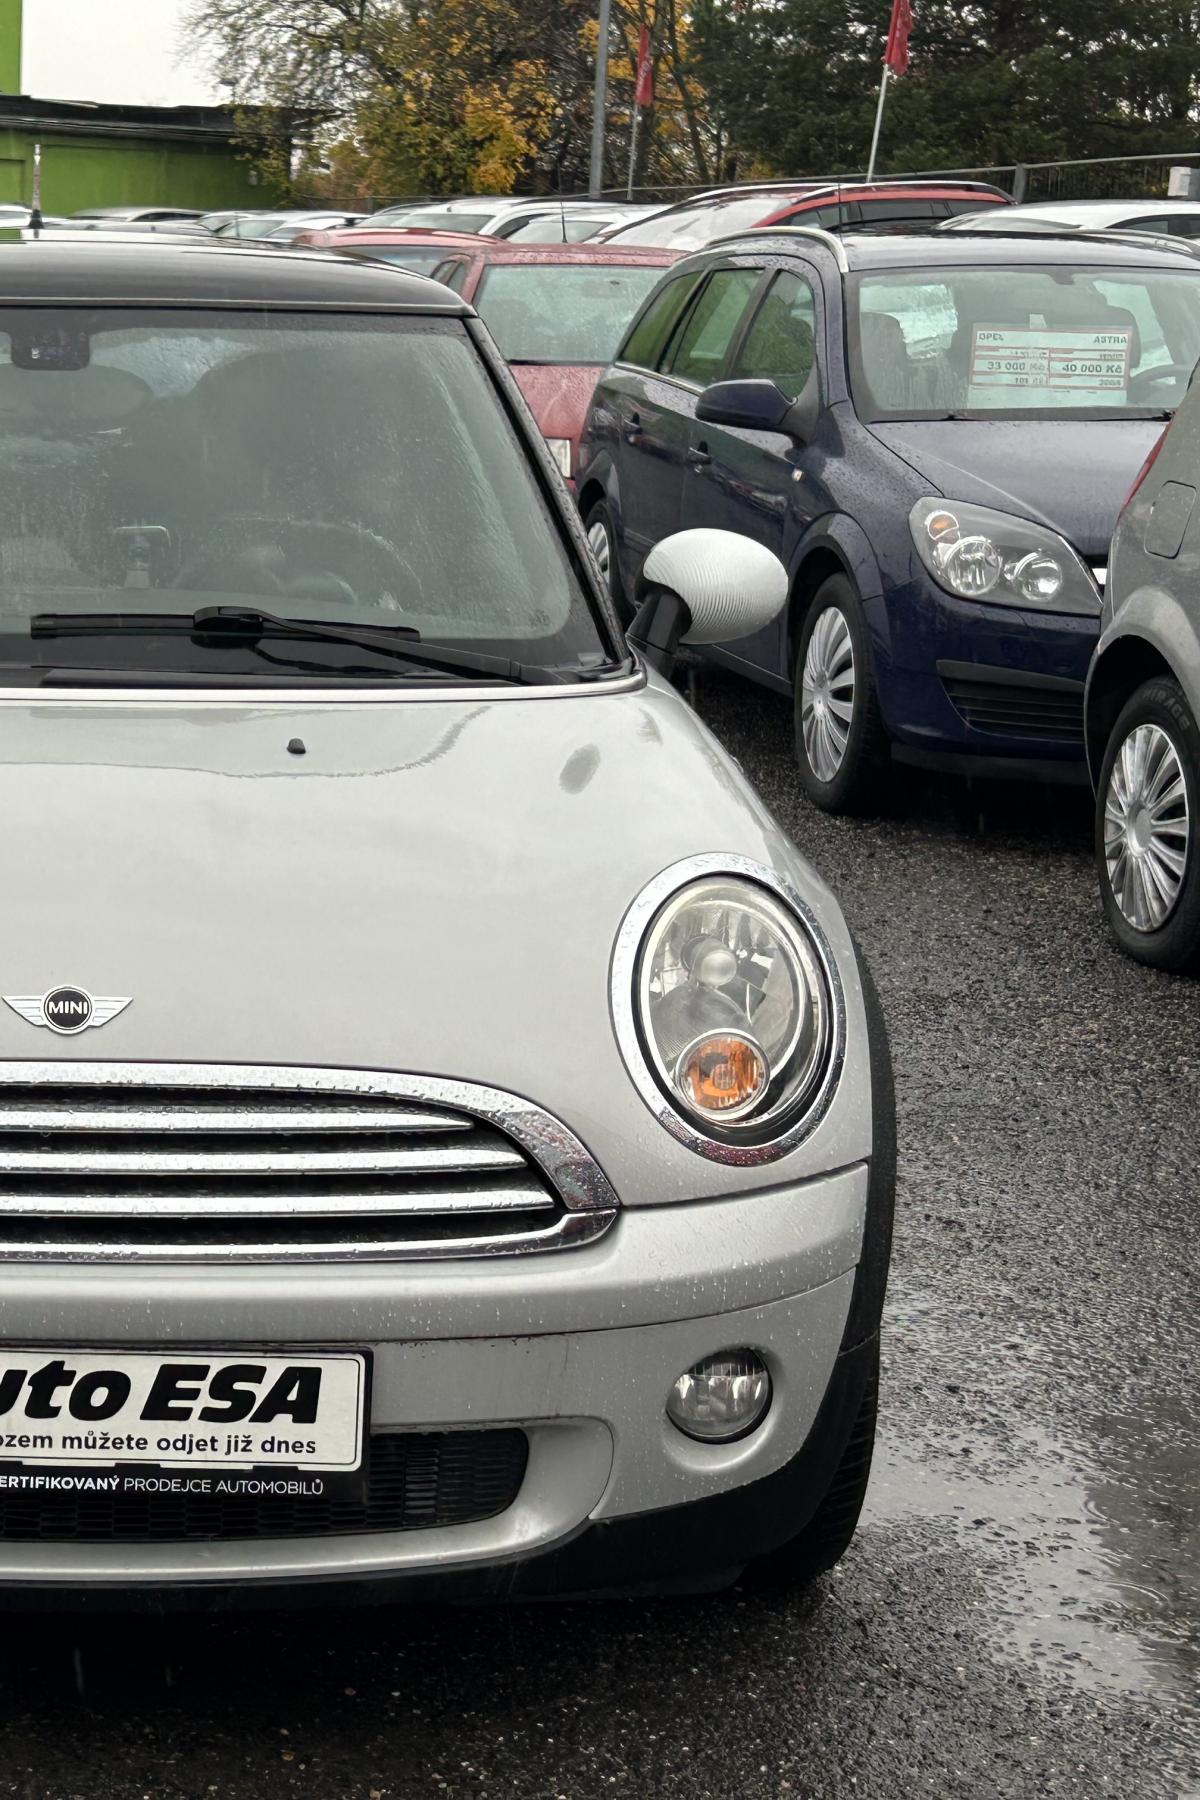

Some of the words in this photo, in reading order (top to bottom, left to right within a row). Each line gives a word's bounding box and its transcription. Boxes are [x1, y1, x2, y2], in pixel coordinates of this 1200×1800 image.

[1093, 335, 1127, 344] ASTRA
[48, 1000, 88, 1014] MINI
[139, 1363, 323, 1424] ESA
[61, 1430, 148, 1450] můžete
[157, 1433, 218, 1455] odjet
[224, 1433, 253, 1456] již
[260, 1436, 316, 1454] dnes
[124, 1477, 211, 1493] PRODEJCE
[215, 1478, 324, 1495] AUTOMOBILŮ
